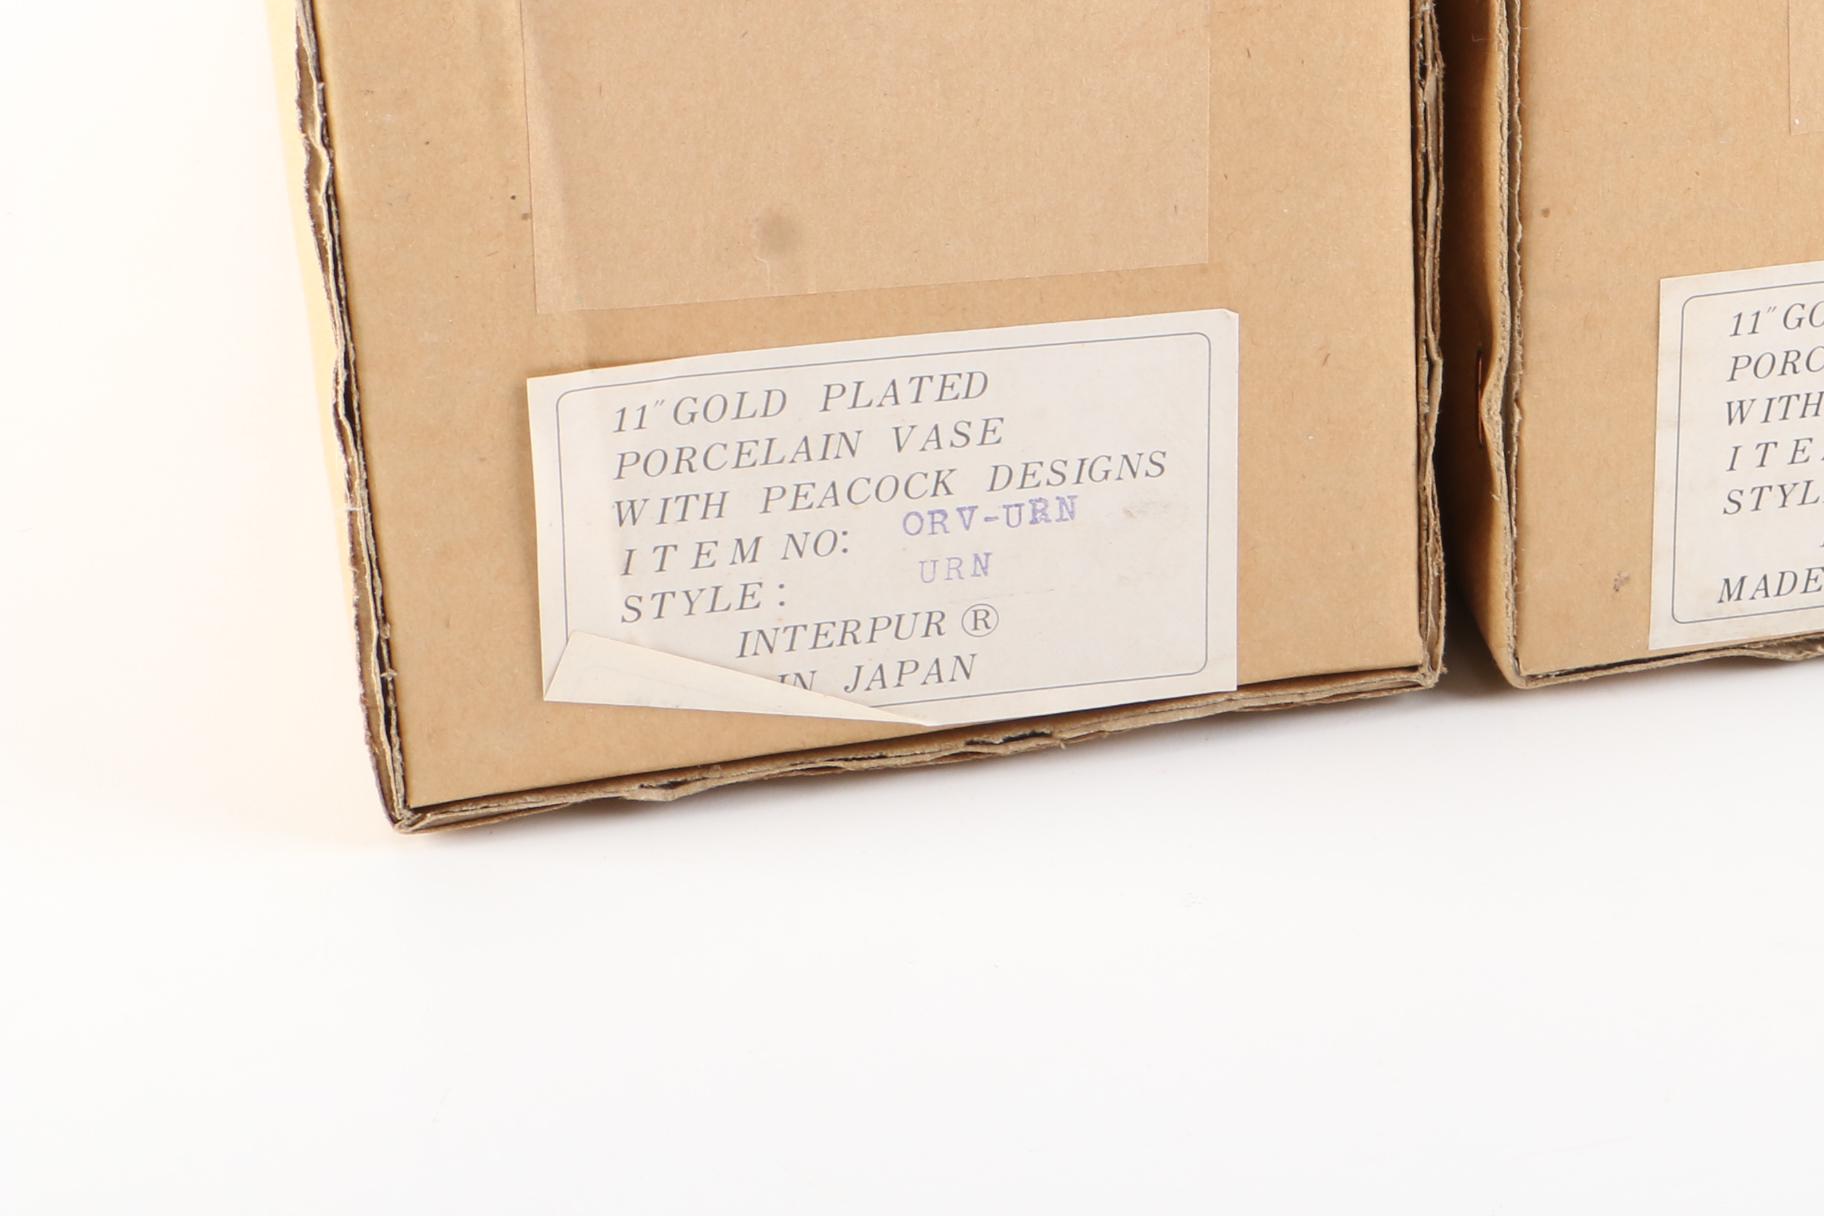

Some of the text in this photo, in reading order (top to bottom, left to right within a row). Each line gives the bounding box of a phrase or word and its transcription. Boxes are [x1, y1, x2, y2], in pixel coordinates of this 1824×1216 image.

[818, 370, 989, 413] PLATED
[613, 416, 1005, 481] PORCELAIN VASE
[613, 449, 1167, 528] WITH PEACOCK DESIGNS
[619, 494, 1080, 577] ITEM NO: ORV-URN
[918, 552, 992, 584] URN
[843, 653, 978, 694] JAPAN
